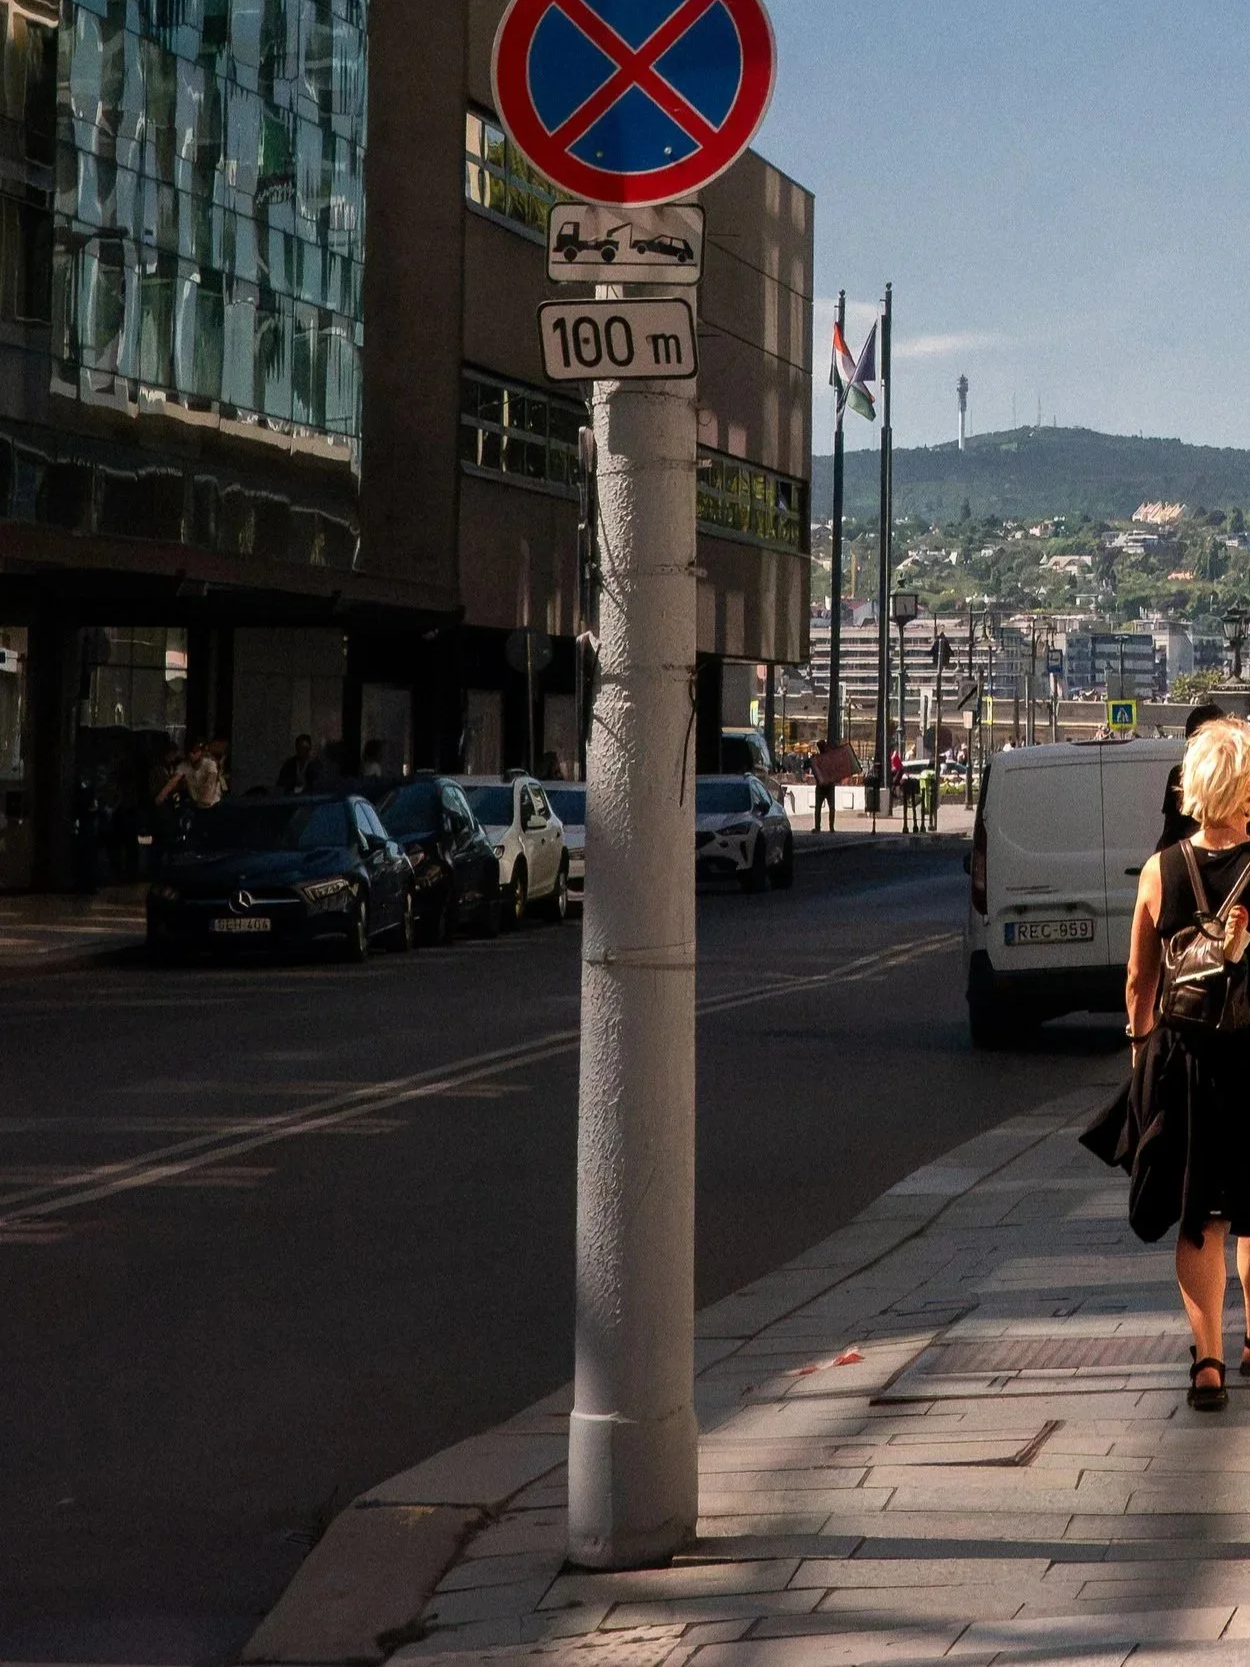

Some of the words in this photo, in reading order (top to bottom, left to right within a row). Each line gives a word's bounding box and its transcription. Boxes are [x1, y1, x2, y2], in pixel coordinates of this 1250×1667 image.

[552, 315, 635, 368] 100
[650, 333, 683, 365] m
[1017, 922, 1088, 939] REC-959
